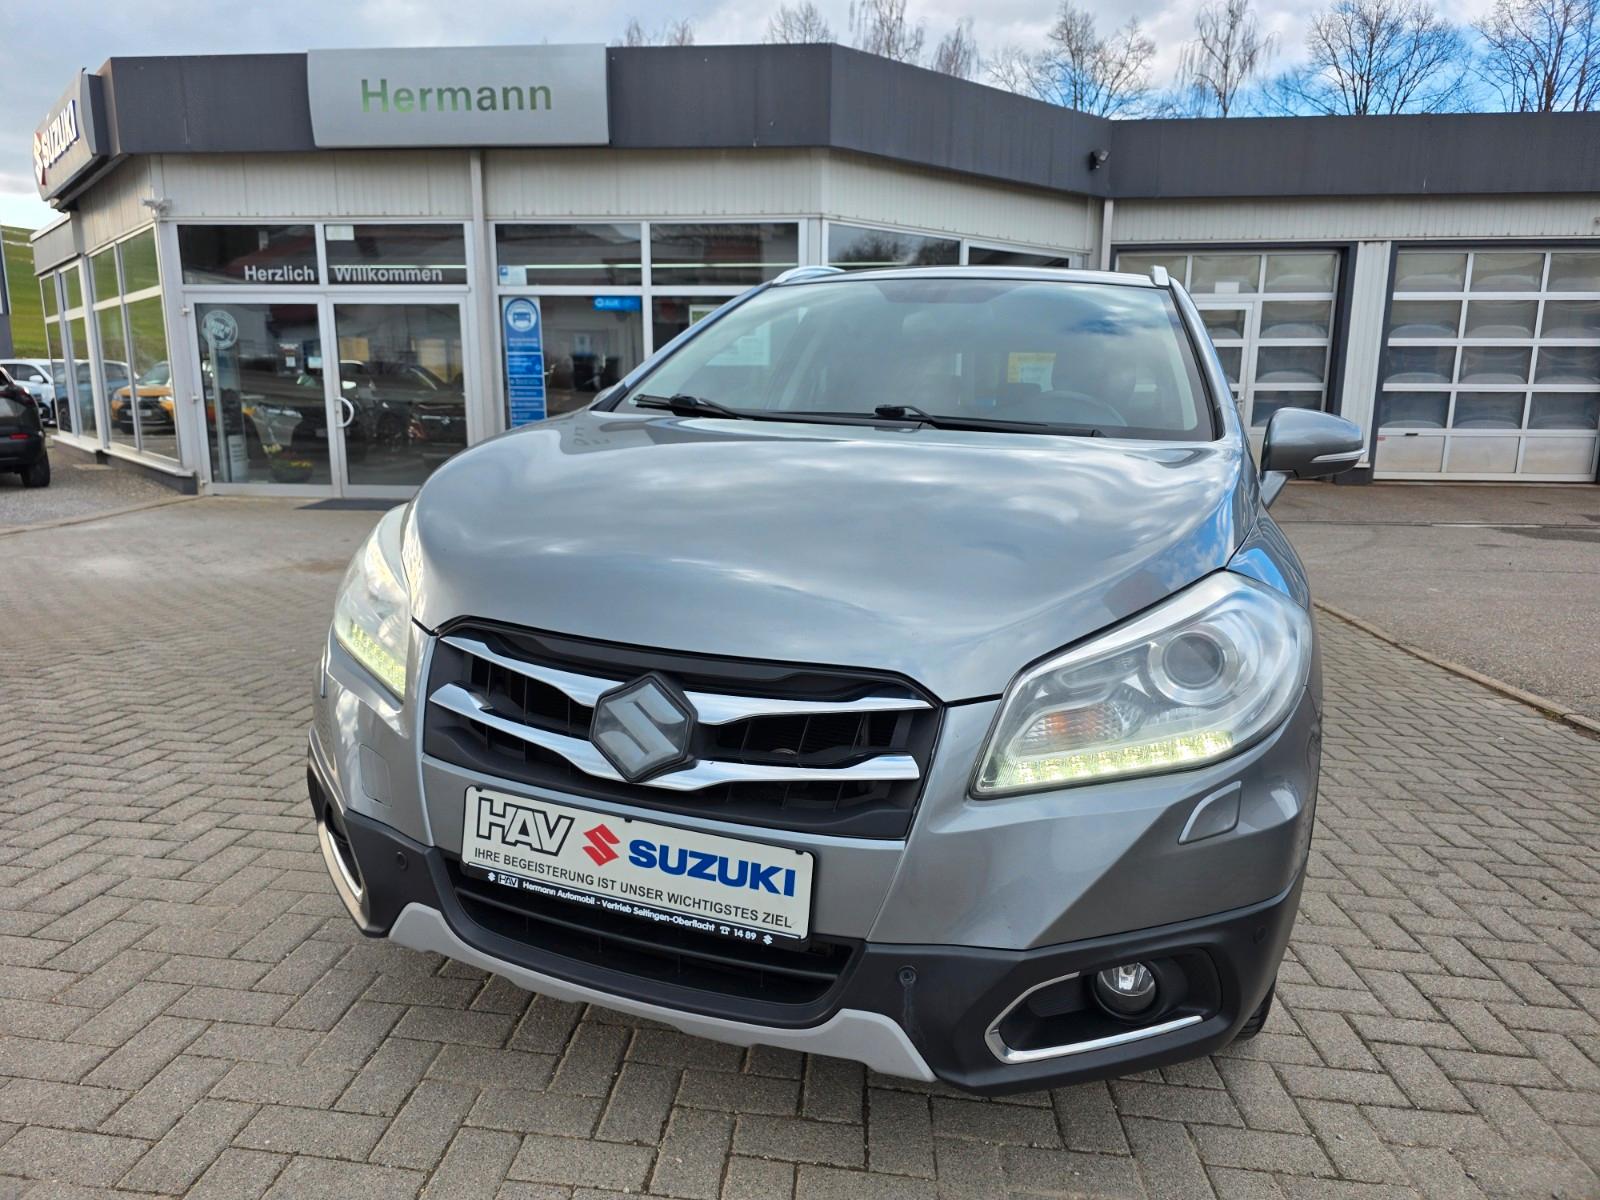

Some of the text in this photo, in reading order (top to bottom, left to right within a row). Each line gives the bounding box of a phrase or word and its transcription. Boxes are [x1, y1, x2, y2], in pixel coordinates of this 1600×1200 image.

[361, 78, 552, 112] Hermann
[41, 99, 80, 169] SUZUKI
[244, 265, 443, 282] Herzlich Willkommen
[476, 796, 796, 897] HAV SUZUKI
[474, 847, 792, 929] IHRE BEGEISTERUNG IST UNSER WICHTIGSTES ZIEL
[498, 873, 519, 888] HAV
[522, 880, 556, 896] Hermann
[557, 889, 595, 905] Automobil
[602, 899, 632, 914] Vertrieb
